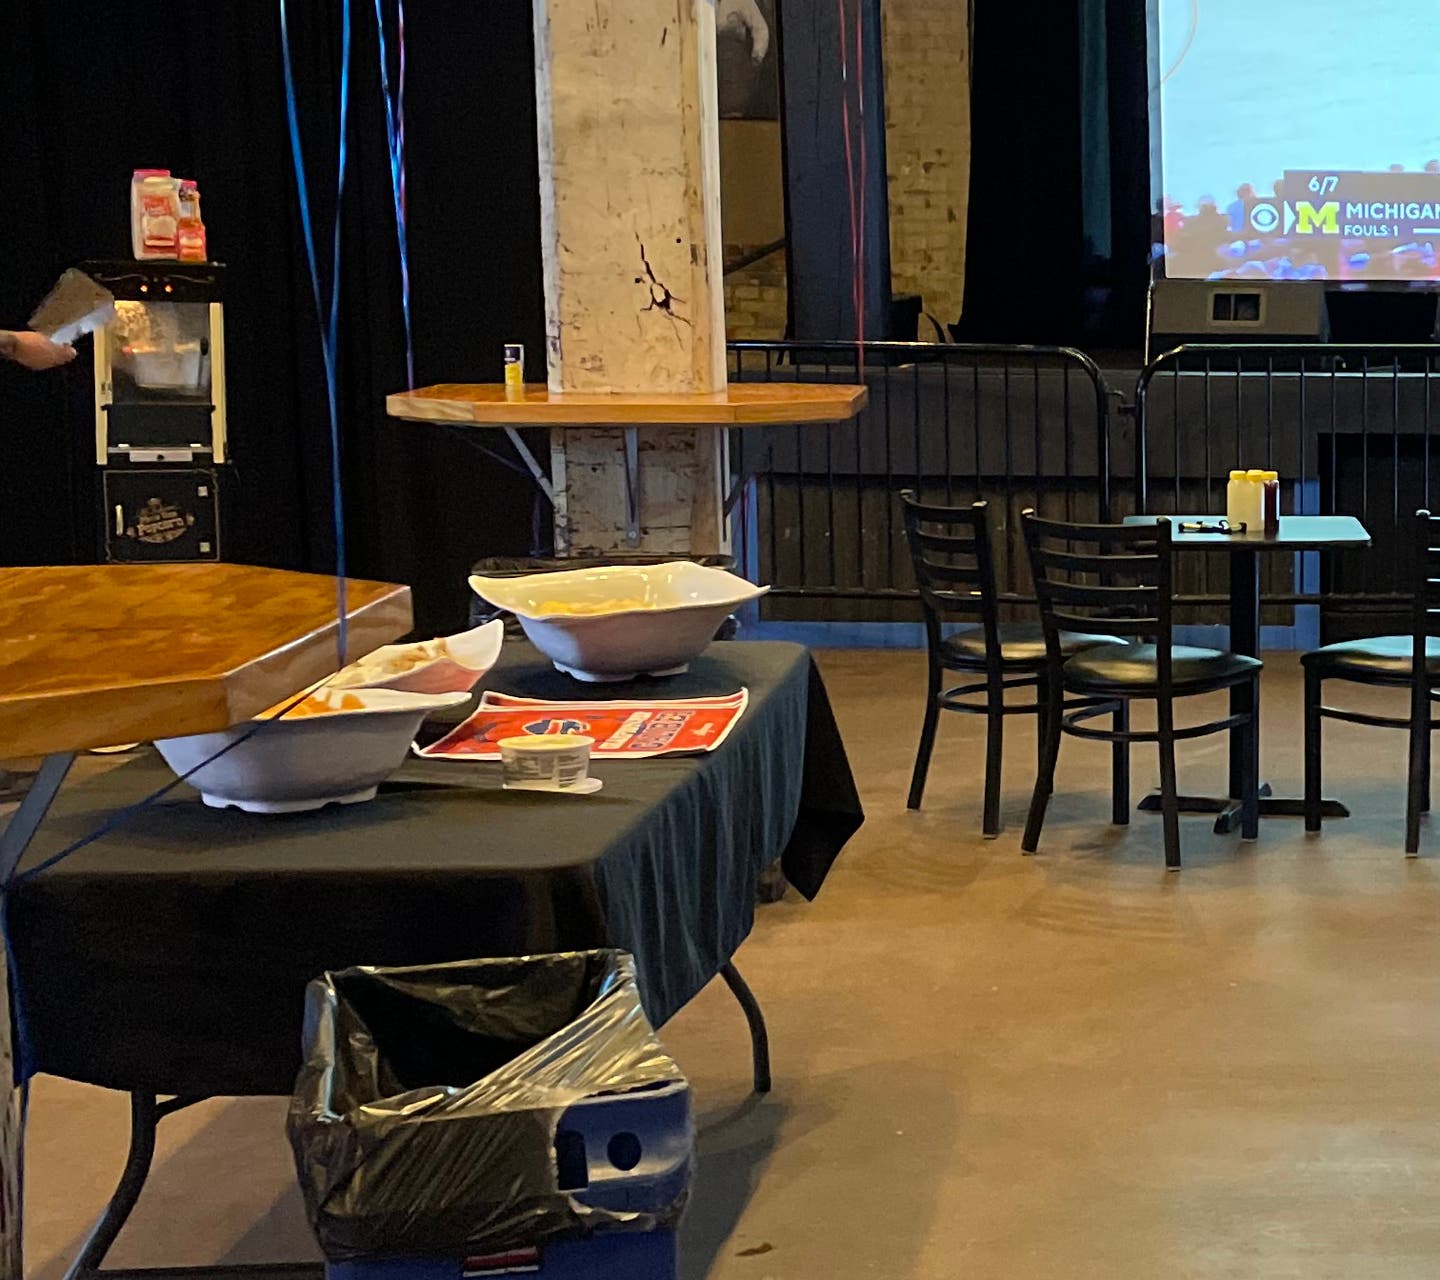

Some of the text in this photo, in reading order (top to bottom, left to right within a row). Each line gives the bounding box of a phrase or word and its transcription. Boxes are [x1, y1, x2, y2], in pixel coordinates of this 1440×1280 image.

[1308, 176, 1339, 195] 6/7
[1295, 201, 1340, 234] M
[1392, 224, 1399, 237] 1
